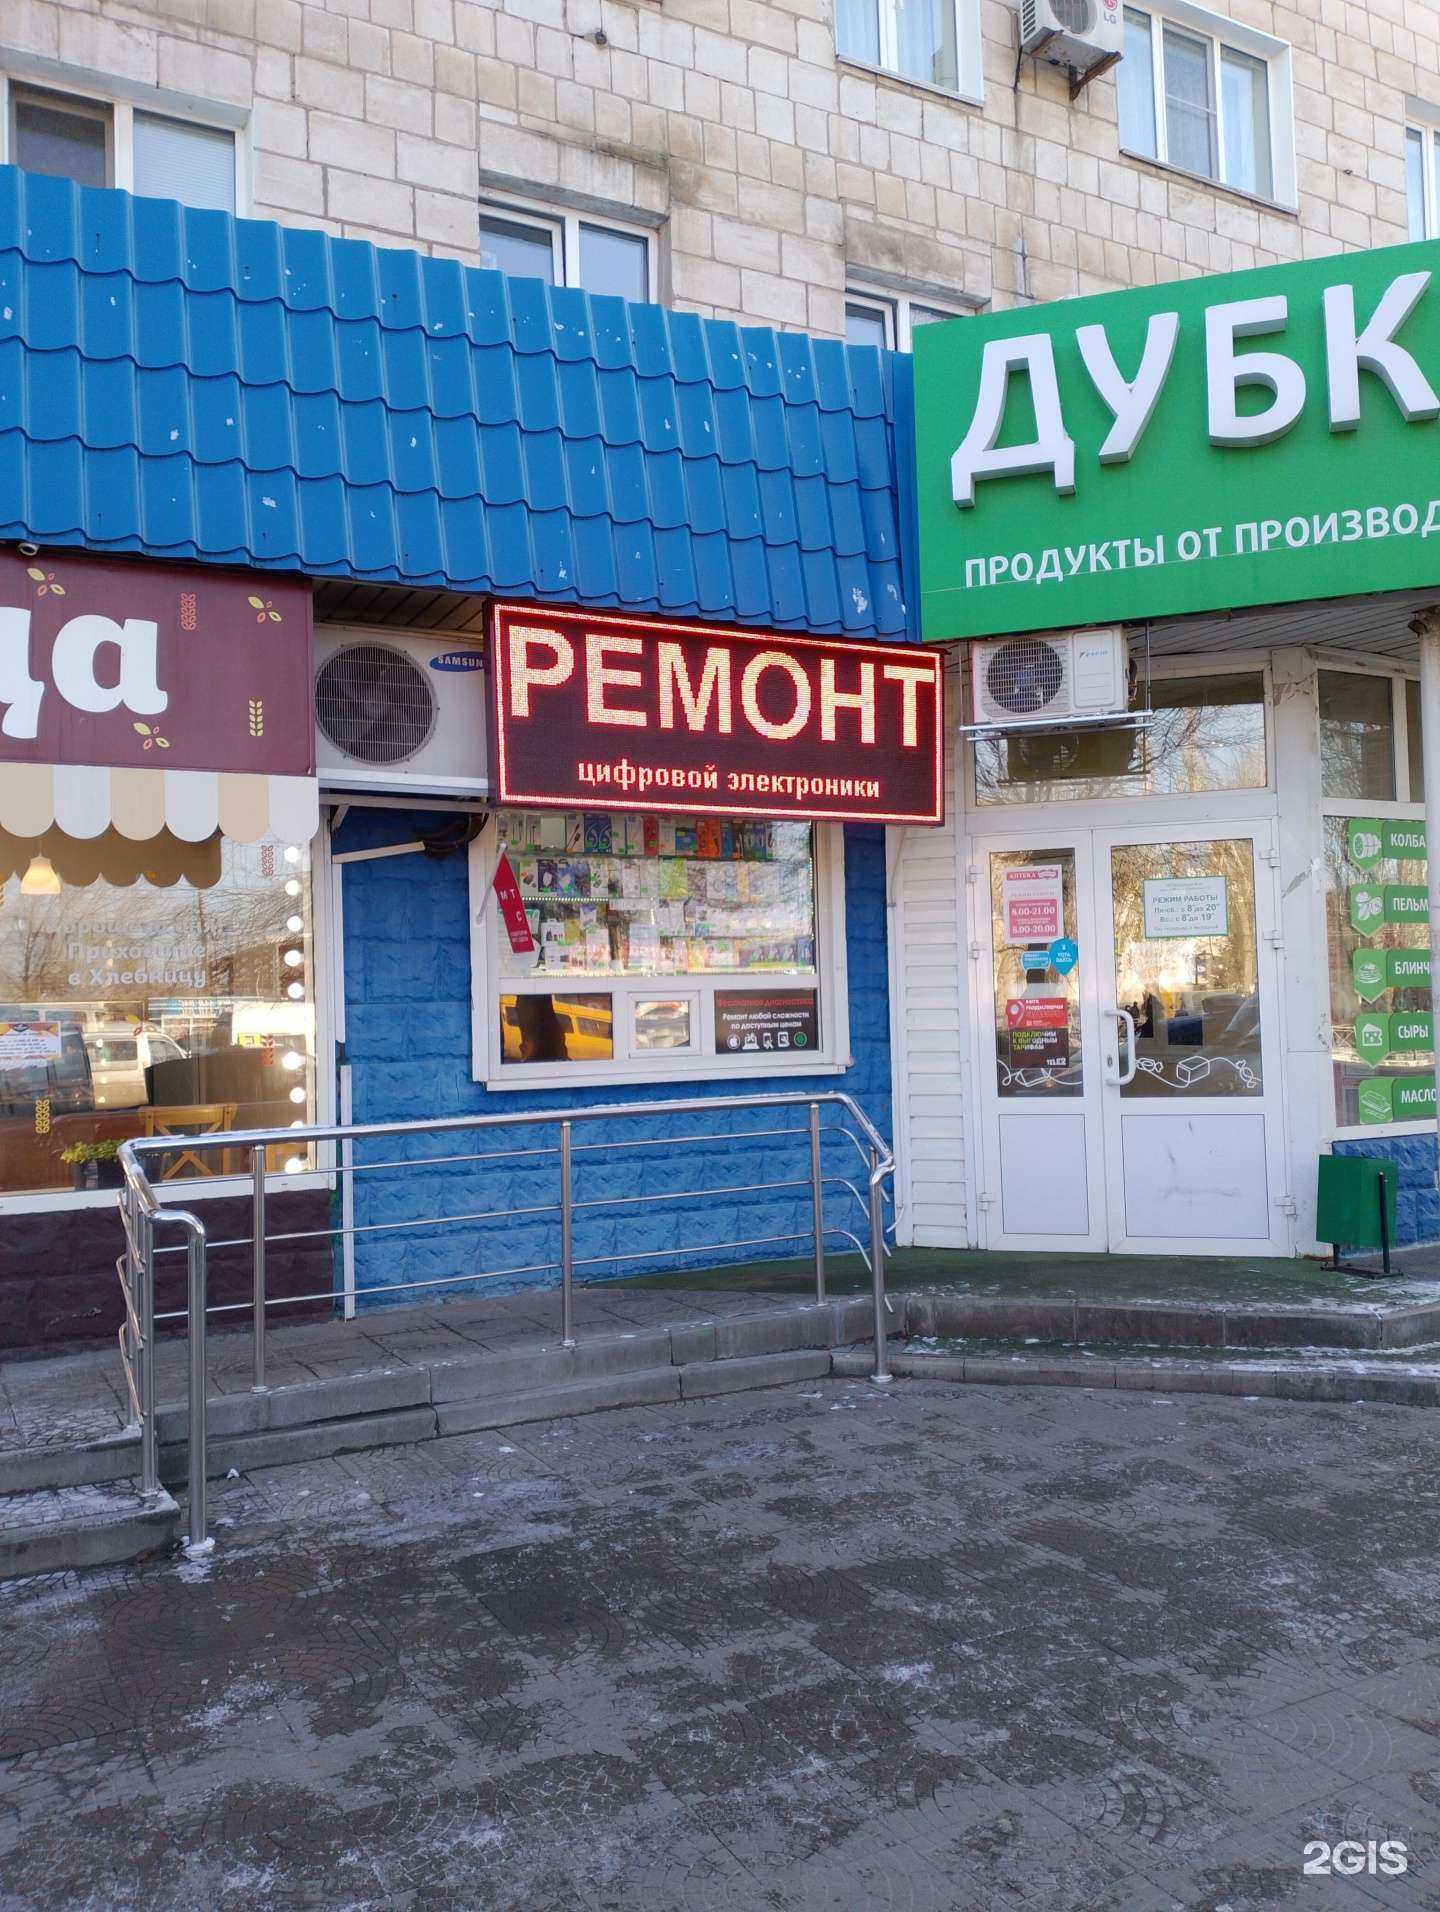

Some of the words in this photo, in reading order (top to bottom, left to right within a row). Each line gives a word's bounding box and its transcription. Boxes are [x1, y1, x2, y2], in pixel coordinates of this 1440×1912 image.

[951, 271, 1440, 508] ДУБК
[965, 534, 1165, 588] ПРОДУКТЫ
[1177, 527, 1223, 562] ОТ
[438, 655, 483, 668] SAMSUN
[508, 624, 936, 747] РЕМОНТ
[578, 759, 718, 791] цифровой
[727, 771, 880, 800] электроники
[1390, 833, 1426, 848] КОЛБА
[1392, 897, 1429, 911] ПЕЛЬМ
[1395, 962, 1431, 975] БЛИНЧ
[90, 967, 206, 988] Хлебницу
[1398, 1025, 1429, 1039] СЫРЫ
[1401, 1088, 1436, 1104] МАСЛО
